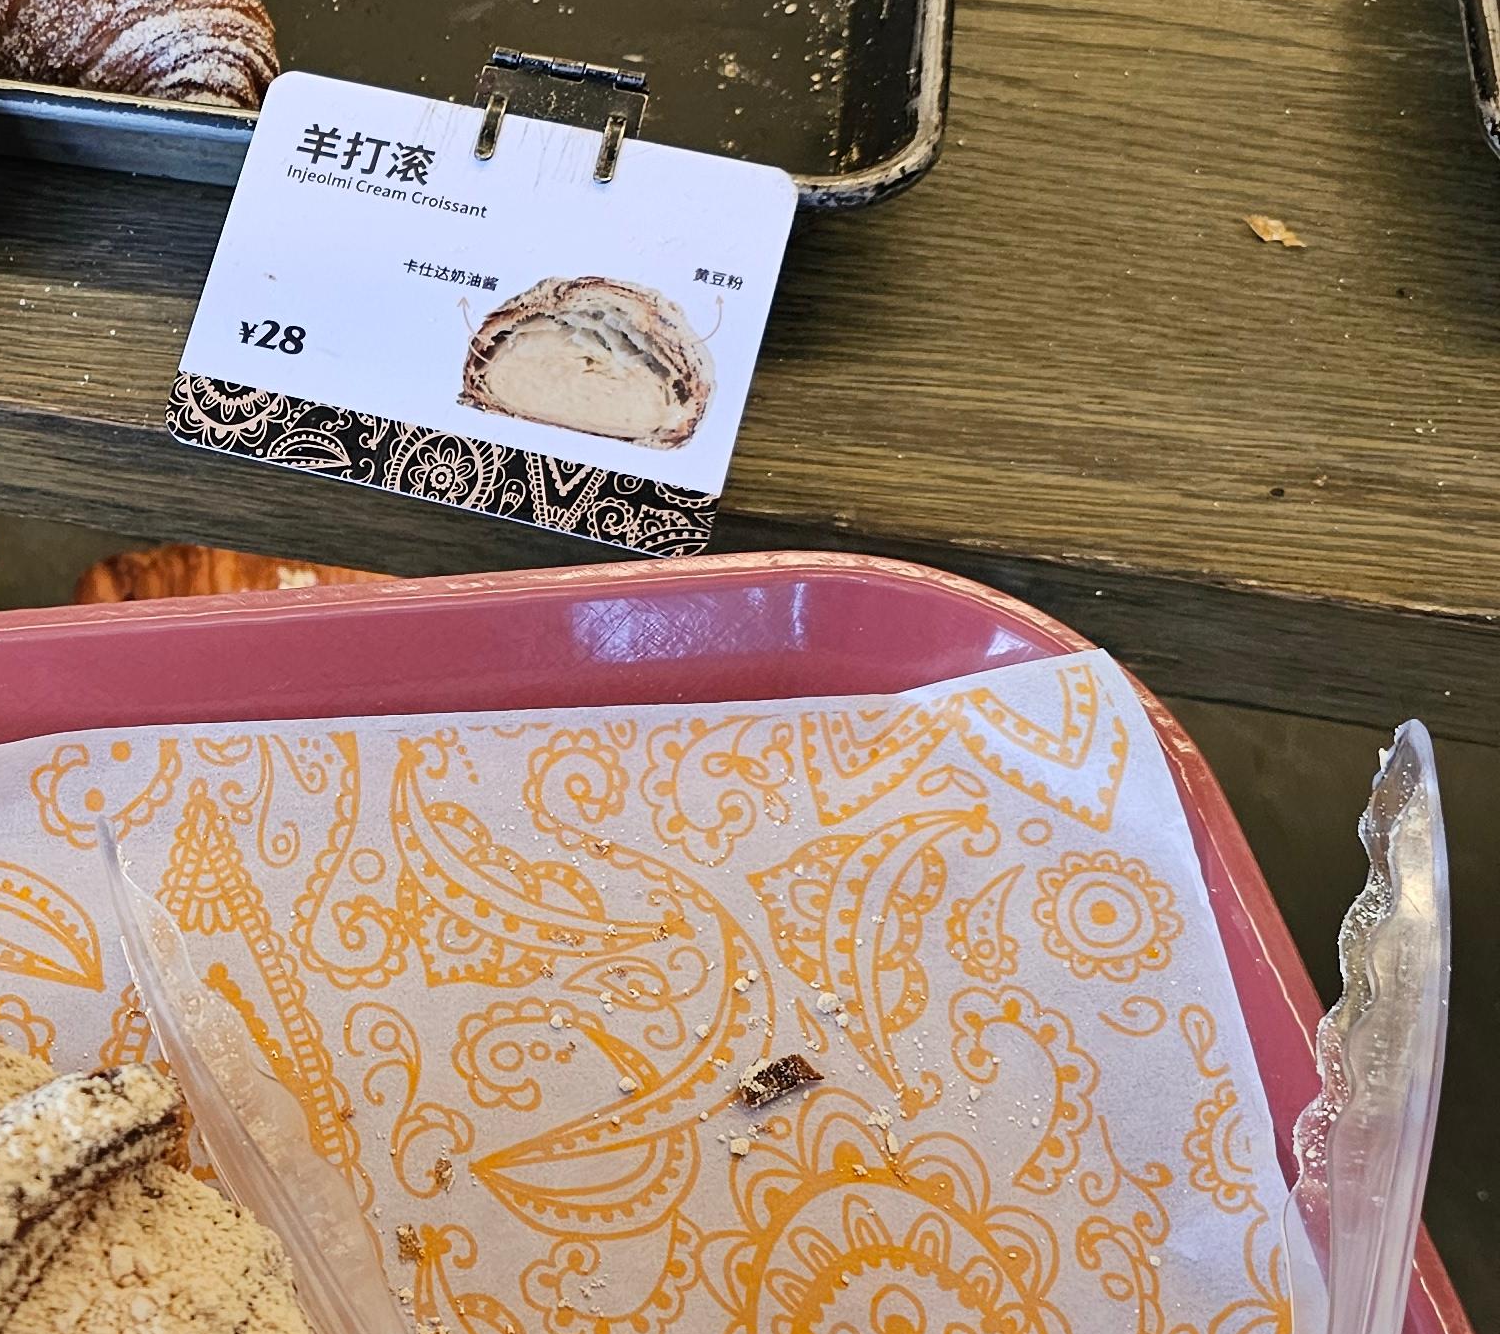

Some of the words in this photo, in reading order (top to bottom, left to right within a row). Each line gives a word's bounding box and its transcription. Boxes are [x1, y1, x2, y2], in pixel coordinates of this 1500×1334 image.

[296, 123, 436, 186] 羊打滚
[287, 164, 353, 189] Injeolmi
[356, 179, 407, 201] Cream
[411, 190, 488, 218] Croissant
[403, 259, 499, 291] 卡仕达奶油酱
[693, 267, 743, 290] 黄豆粉
[238, 319, 307, 355] ¥28
